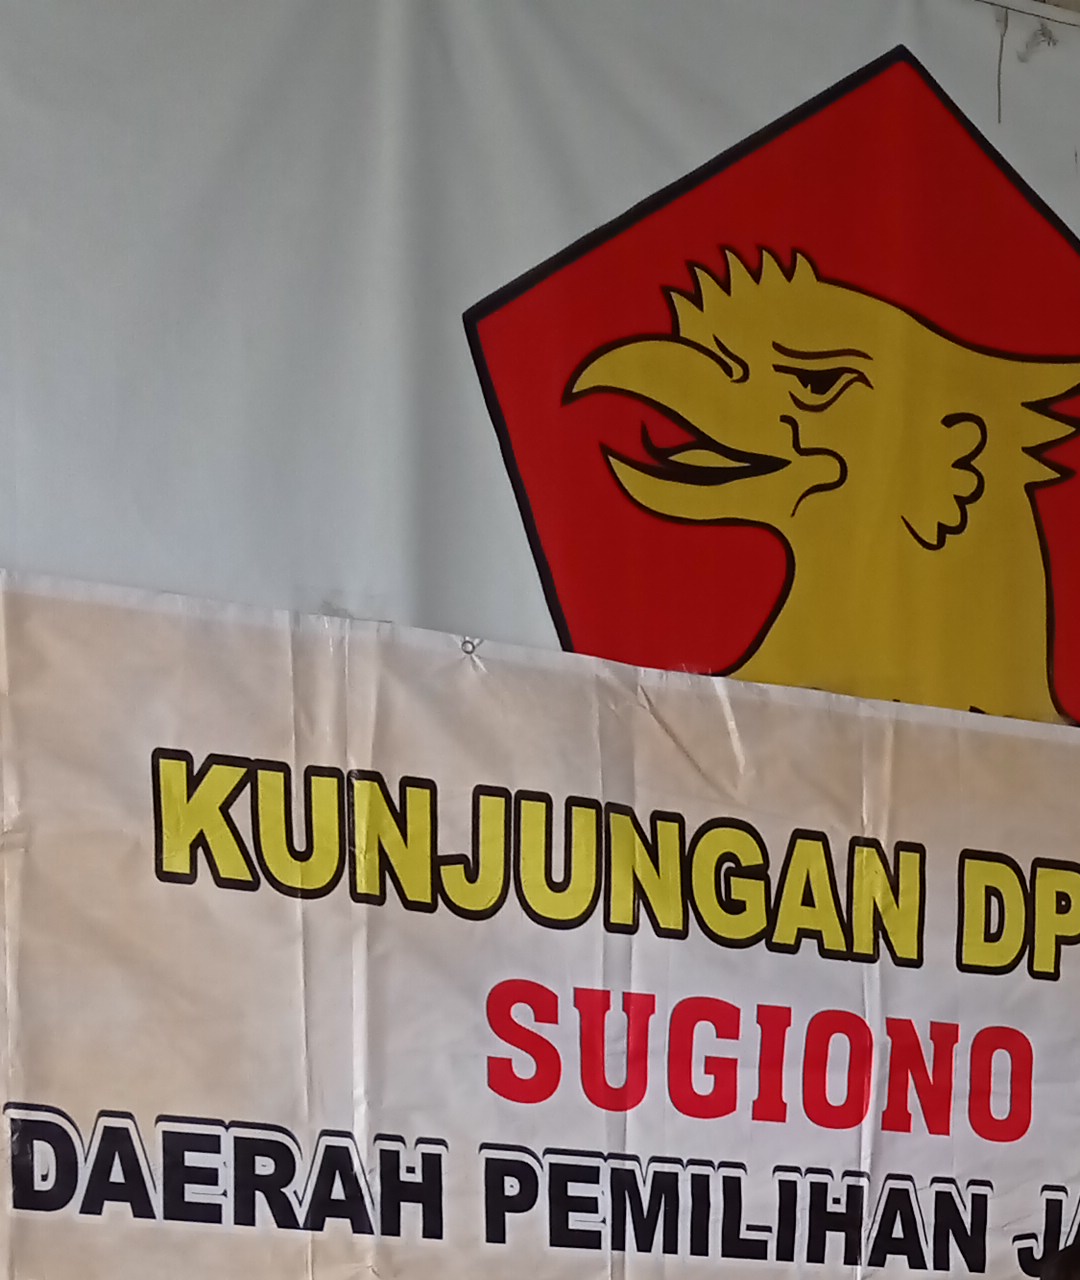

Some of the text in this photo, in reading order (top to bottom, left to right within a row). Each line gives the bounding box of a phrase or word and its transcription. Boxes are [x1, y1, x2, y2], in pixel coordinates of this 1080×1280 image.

[152, 748, 925, 967] KUNJUNGAN
[485, 978, 1034, 1142] SUGIONO
[4, 1102, 449, 1240] DAERAH
[479, 1143, 994, 1274] PEMILIHAN
